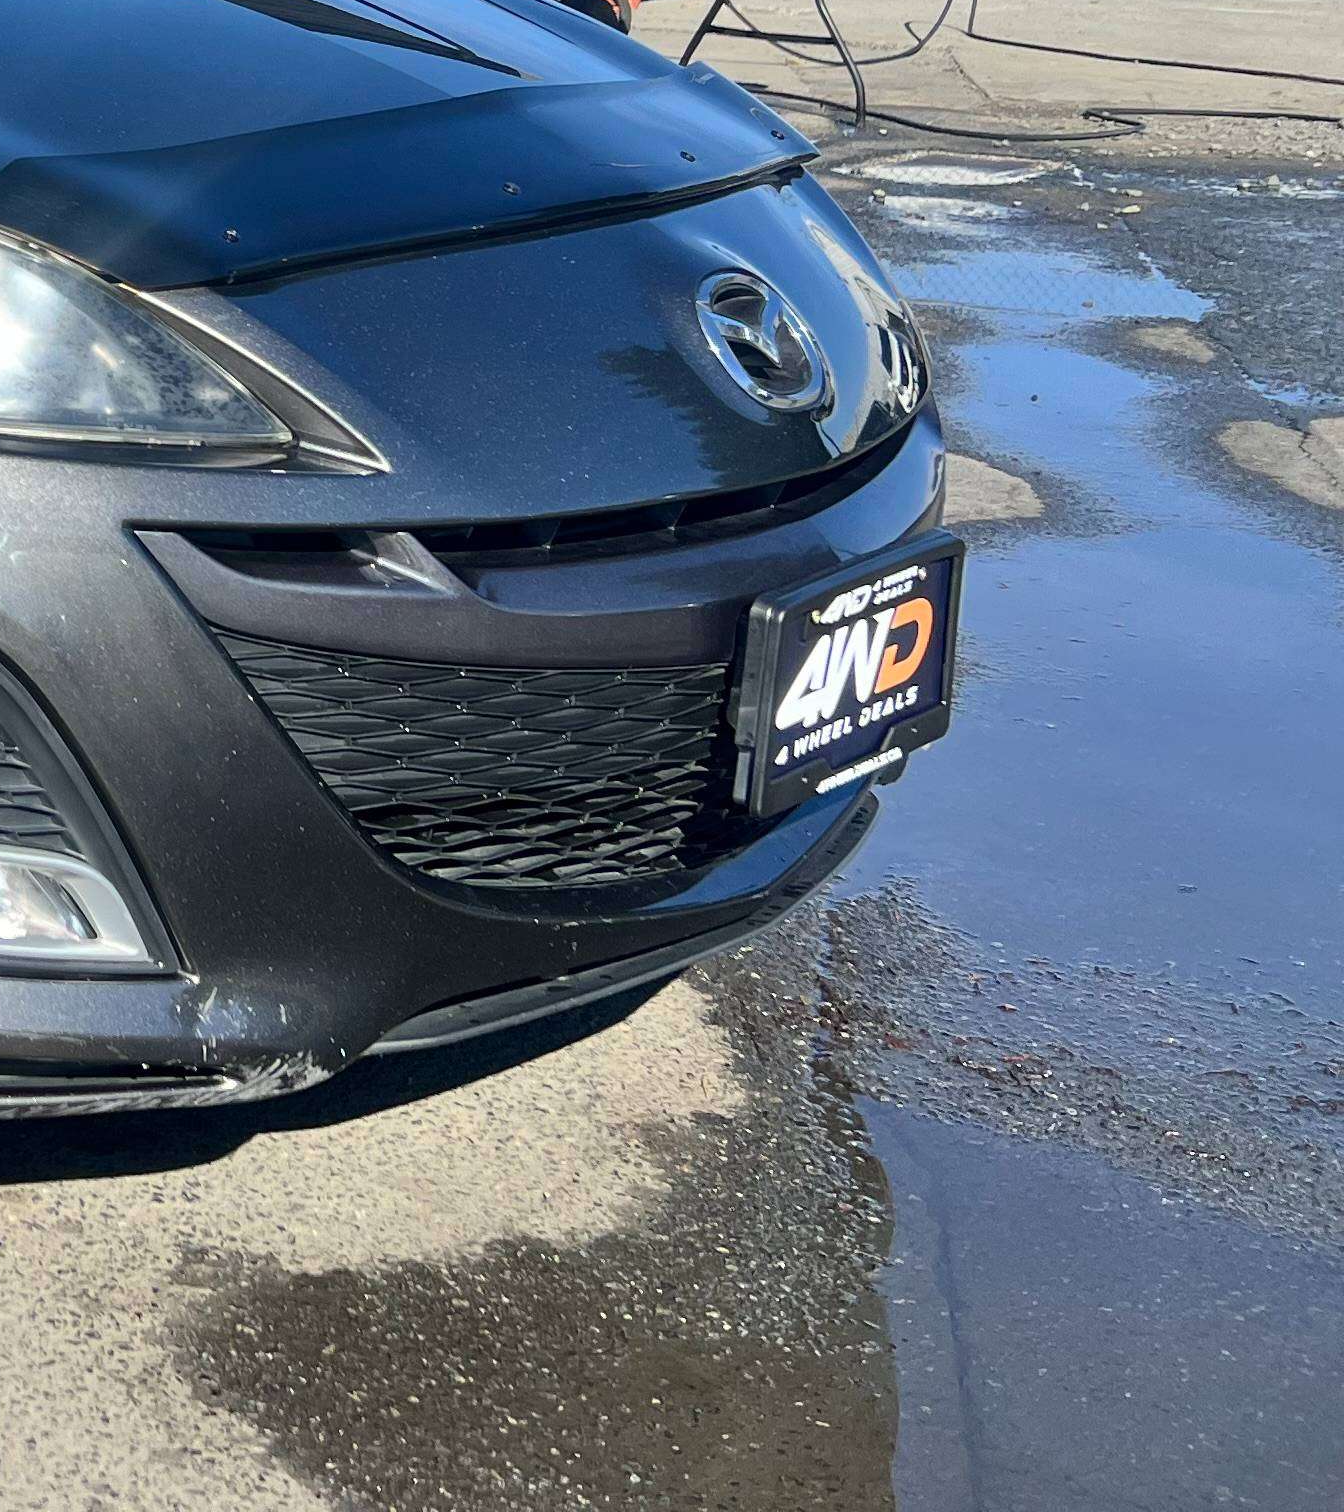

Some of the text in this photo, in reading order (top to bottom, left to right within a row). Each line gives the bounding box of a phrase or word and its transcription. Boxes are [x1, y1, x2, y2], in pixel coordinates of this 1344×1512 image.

[775, 597, 933, 730] 4WD
[774, 685, 919, 766] 4 WHEEL DEALS
